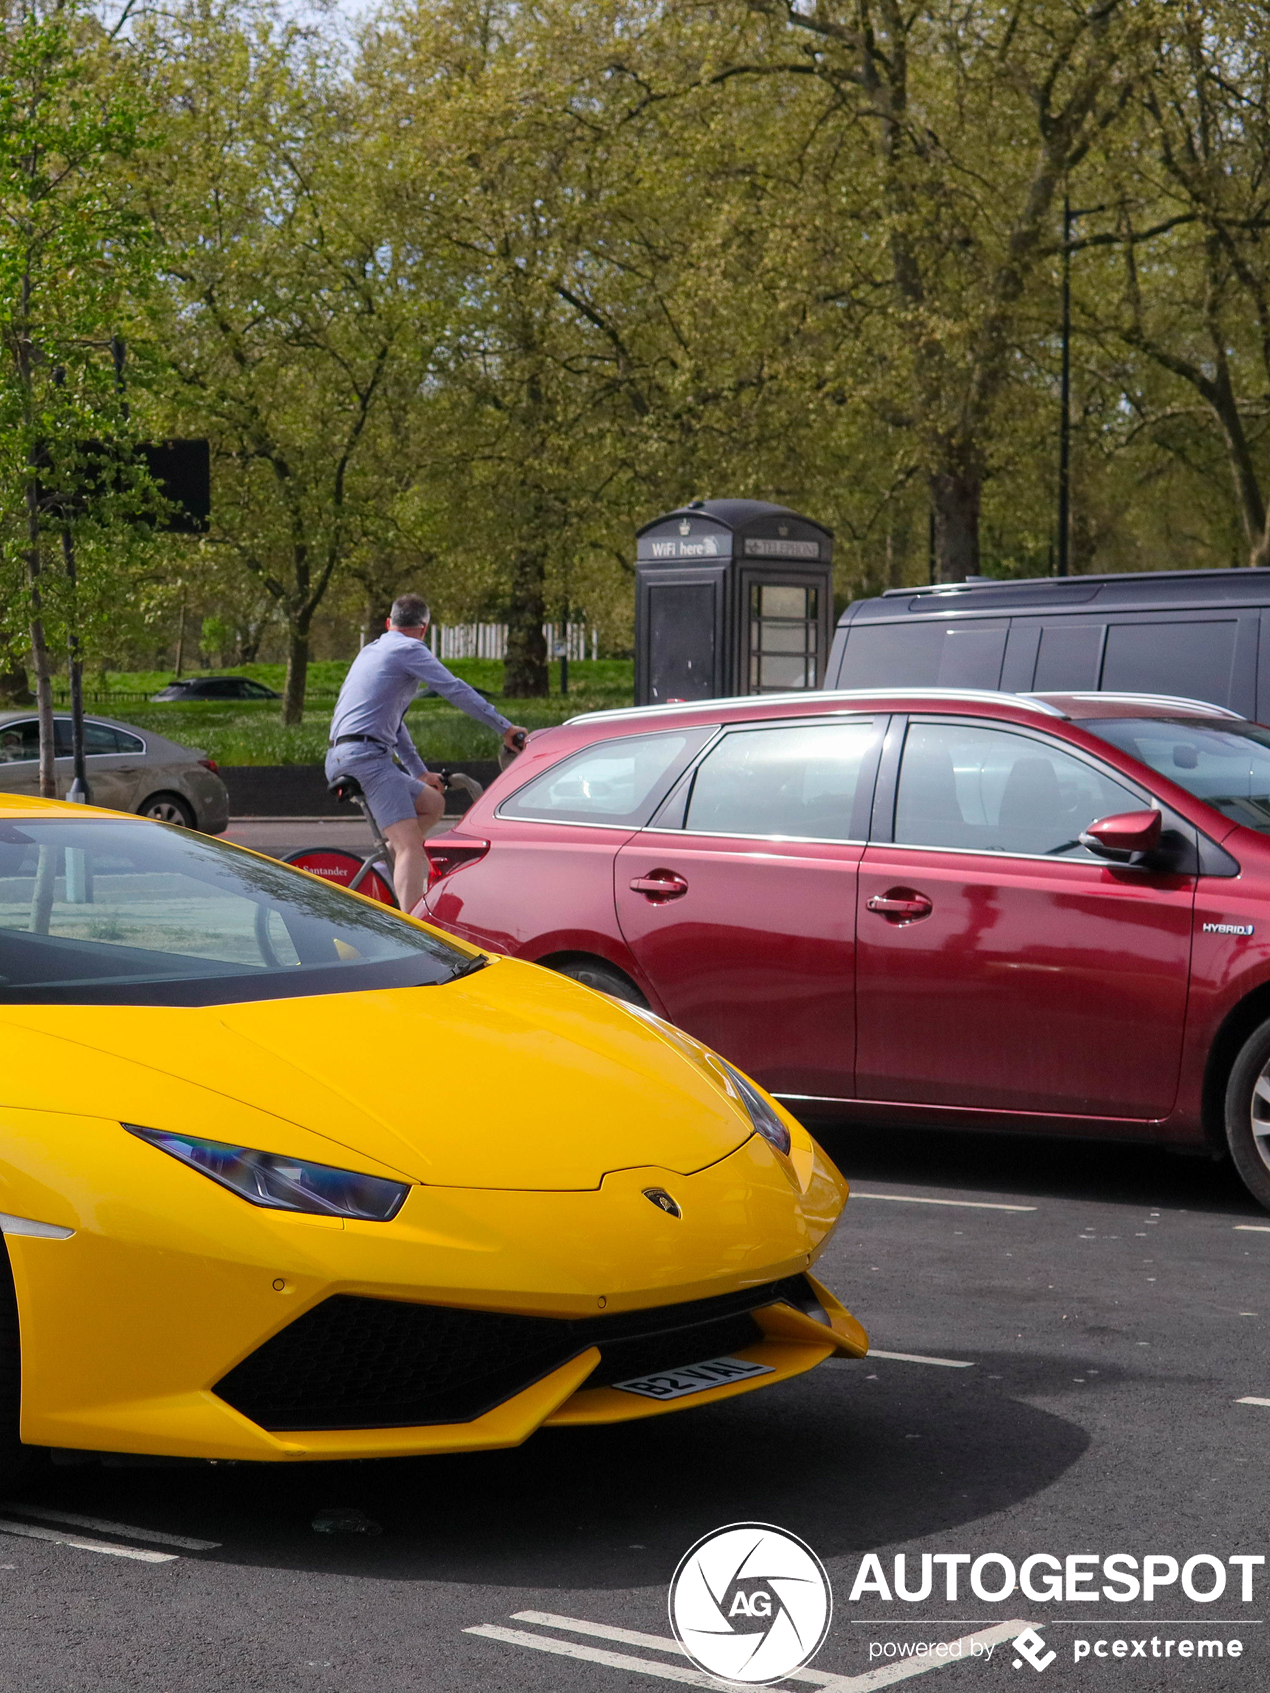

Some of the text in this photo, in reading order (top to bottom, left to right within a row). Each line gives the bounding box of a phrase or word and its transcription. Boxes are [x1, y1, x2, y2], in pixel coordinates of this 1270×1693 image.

[651, 541, 704, 556] WiFi here
[302, 865, 348, 877] Santander
[623, 1376, 697, 1395] B2
[673, 1361, 765, 1382] VAL
